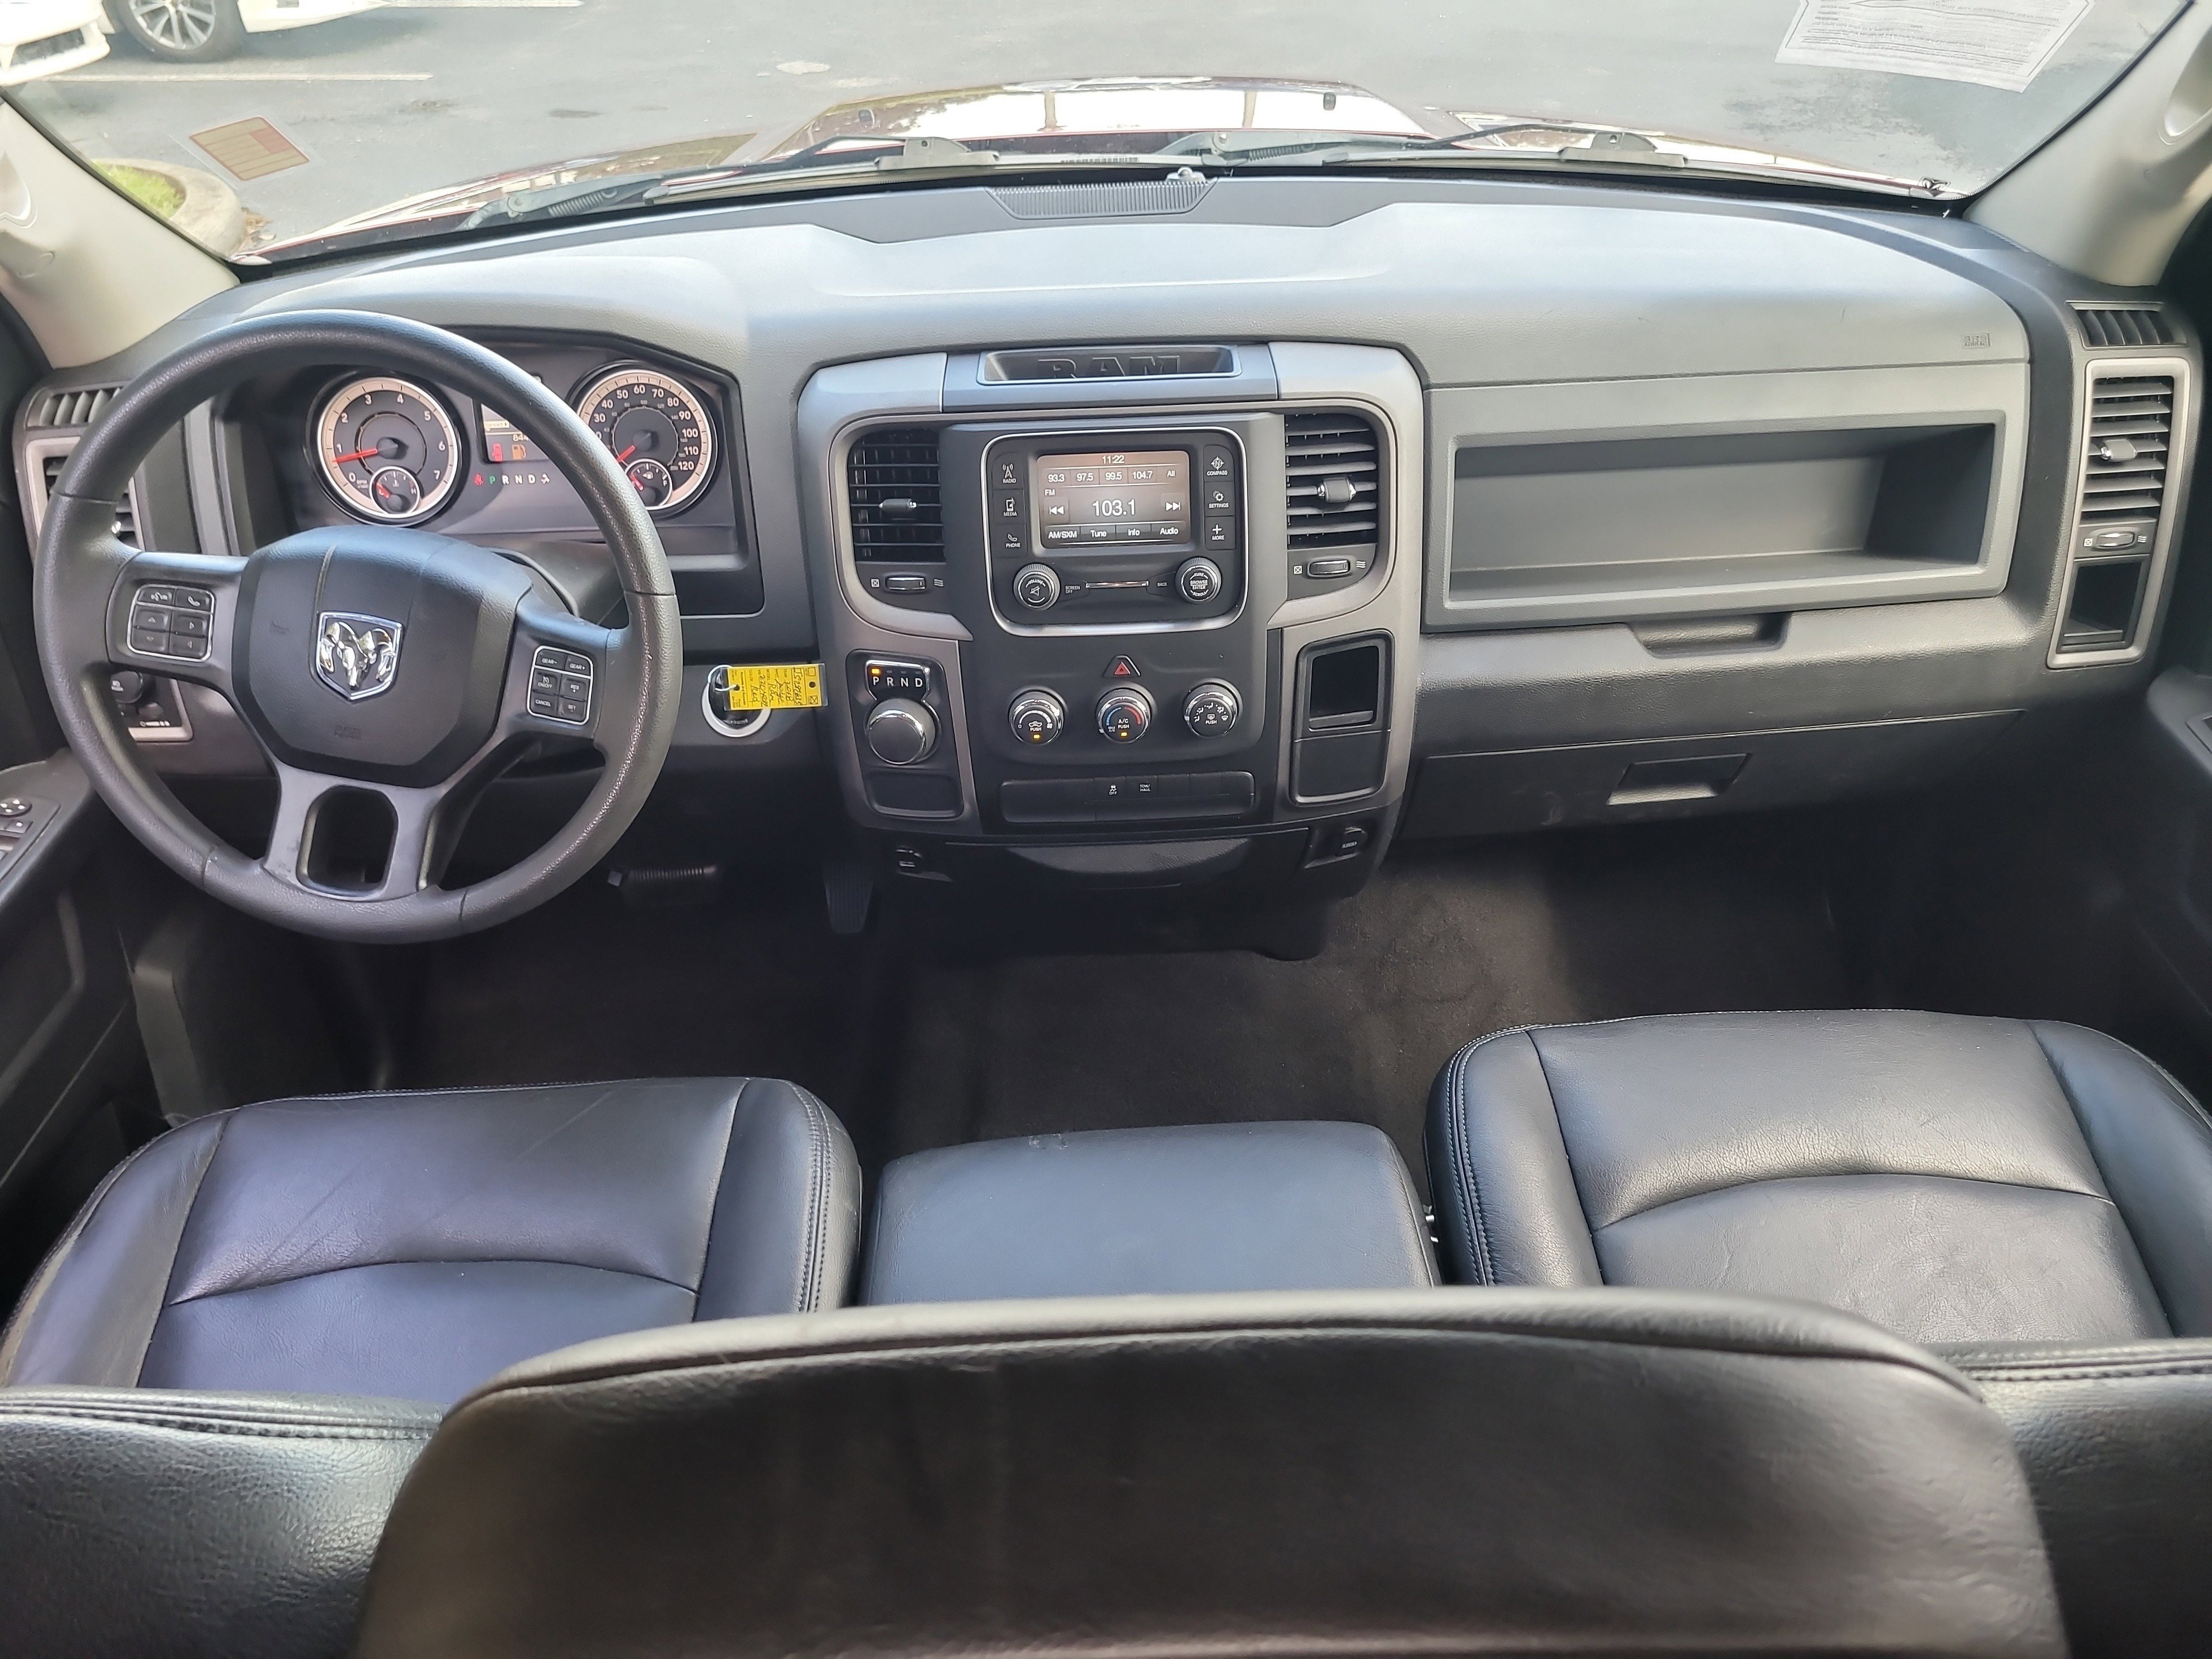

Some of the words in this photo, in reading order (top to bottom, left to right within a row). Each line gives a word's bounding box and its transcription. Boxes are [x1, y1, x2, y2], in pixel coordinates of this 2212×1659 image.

[1038, 355, 1180, 379] RAM
[616, 389, 629, 399] 50
[634, 385, 646, 394] 60
[652, 388, 664, 398] 70
[364, 394, 372, 405] 3
[397, 393, 404, 405] 4
[601, 399, 613, 409] 40
[667, 397, 679, 407] 80
[341, 413, 348, 424] 2
[424, 410, 431, 421] 5
[594, 413, 606, 423] 30
[679, 410, 691, 421] 90
[681, 428, 698, 438] 100
[336, 443, 342, 454] 1
[438, 441, 445, 452] 6
[684, 446, 699, 456] 110
[1102, 455, 1125, 464] 11:22
[678, 461, 695, 471] 120
[348, 472, 356, 482] 0
[433, 470, 441, 480] 7
[489, 475, 496, 484] P
[502, 474, 510, 484] R
[515, 474, 523, 484] N
[528, 474, 536, 484] D
[1048, 474, 1065, 482] 93.3
[1076, 472, 1093, 481] 97.5
[1105, 472, 1122, 480] 99.5
[1132, 471, 1153, 479] 104.7
[1092, 499, 1135, 516] 103.1
[1048, 530, 1077, 539] AM/SXM
[1160, 527, 1179, 535] Audio
[872, 676, 879, 686] P
[887, 676, 894, 686] R
[900, 677, 909, 687] N
[915, 678, 923, 687] D
